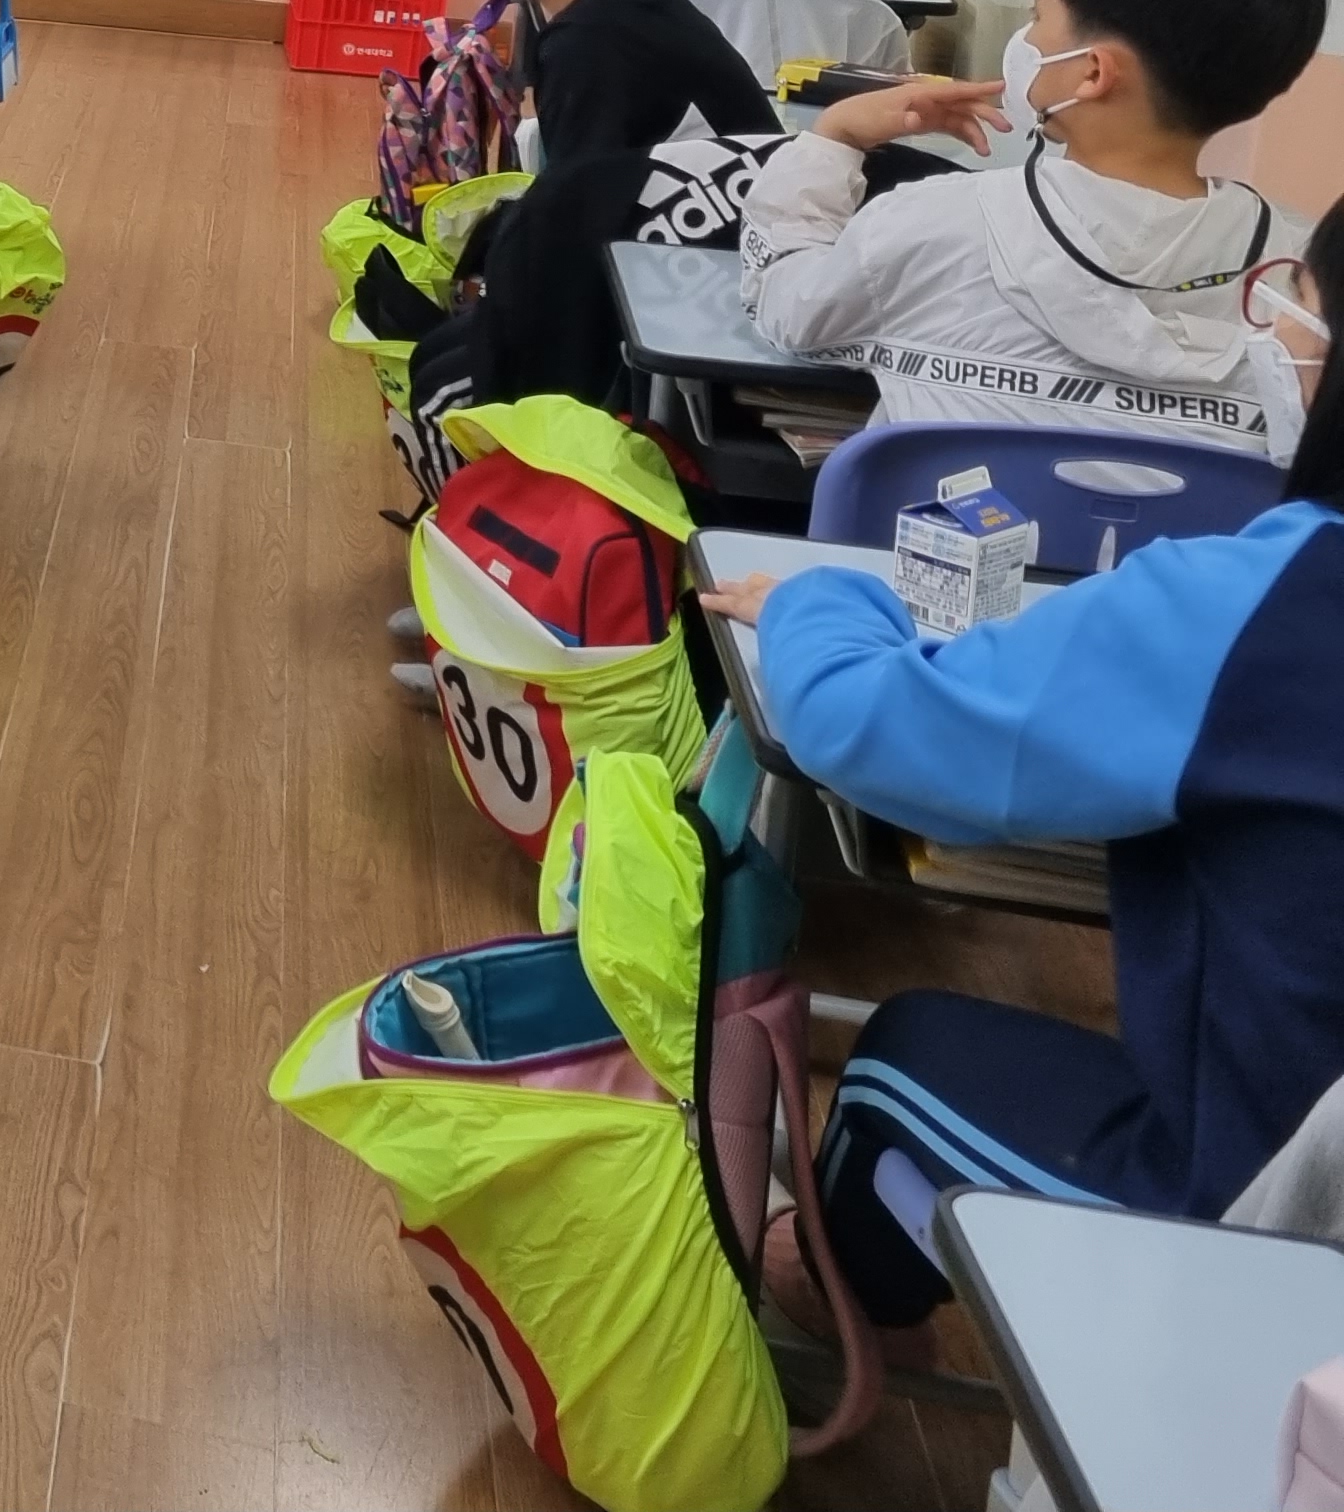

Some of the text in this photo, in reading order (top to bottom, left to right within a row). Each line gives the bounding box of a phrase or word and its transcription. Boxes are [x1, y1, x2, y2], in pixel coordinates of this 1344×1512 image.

[637, 151, 762, 246] adid
[929, 358, 1241, 426] SUPERB SUPERB
[443, 664, 538, 803] 30
